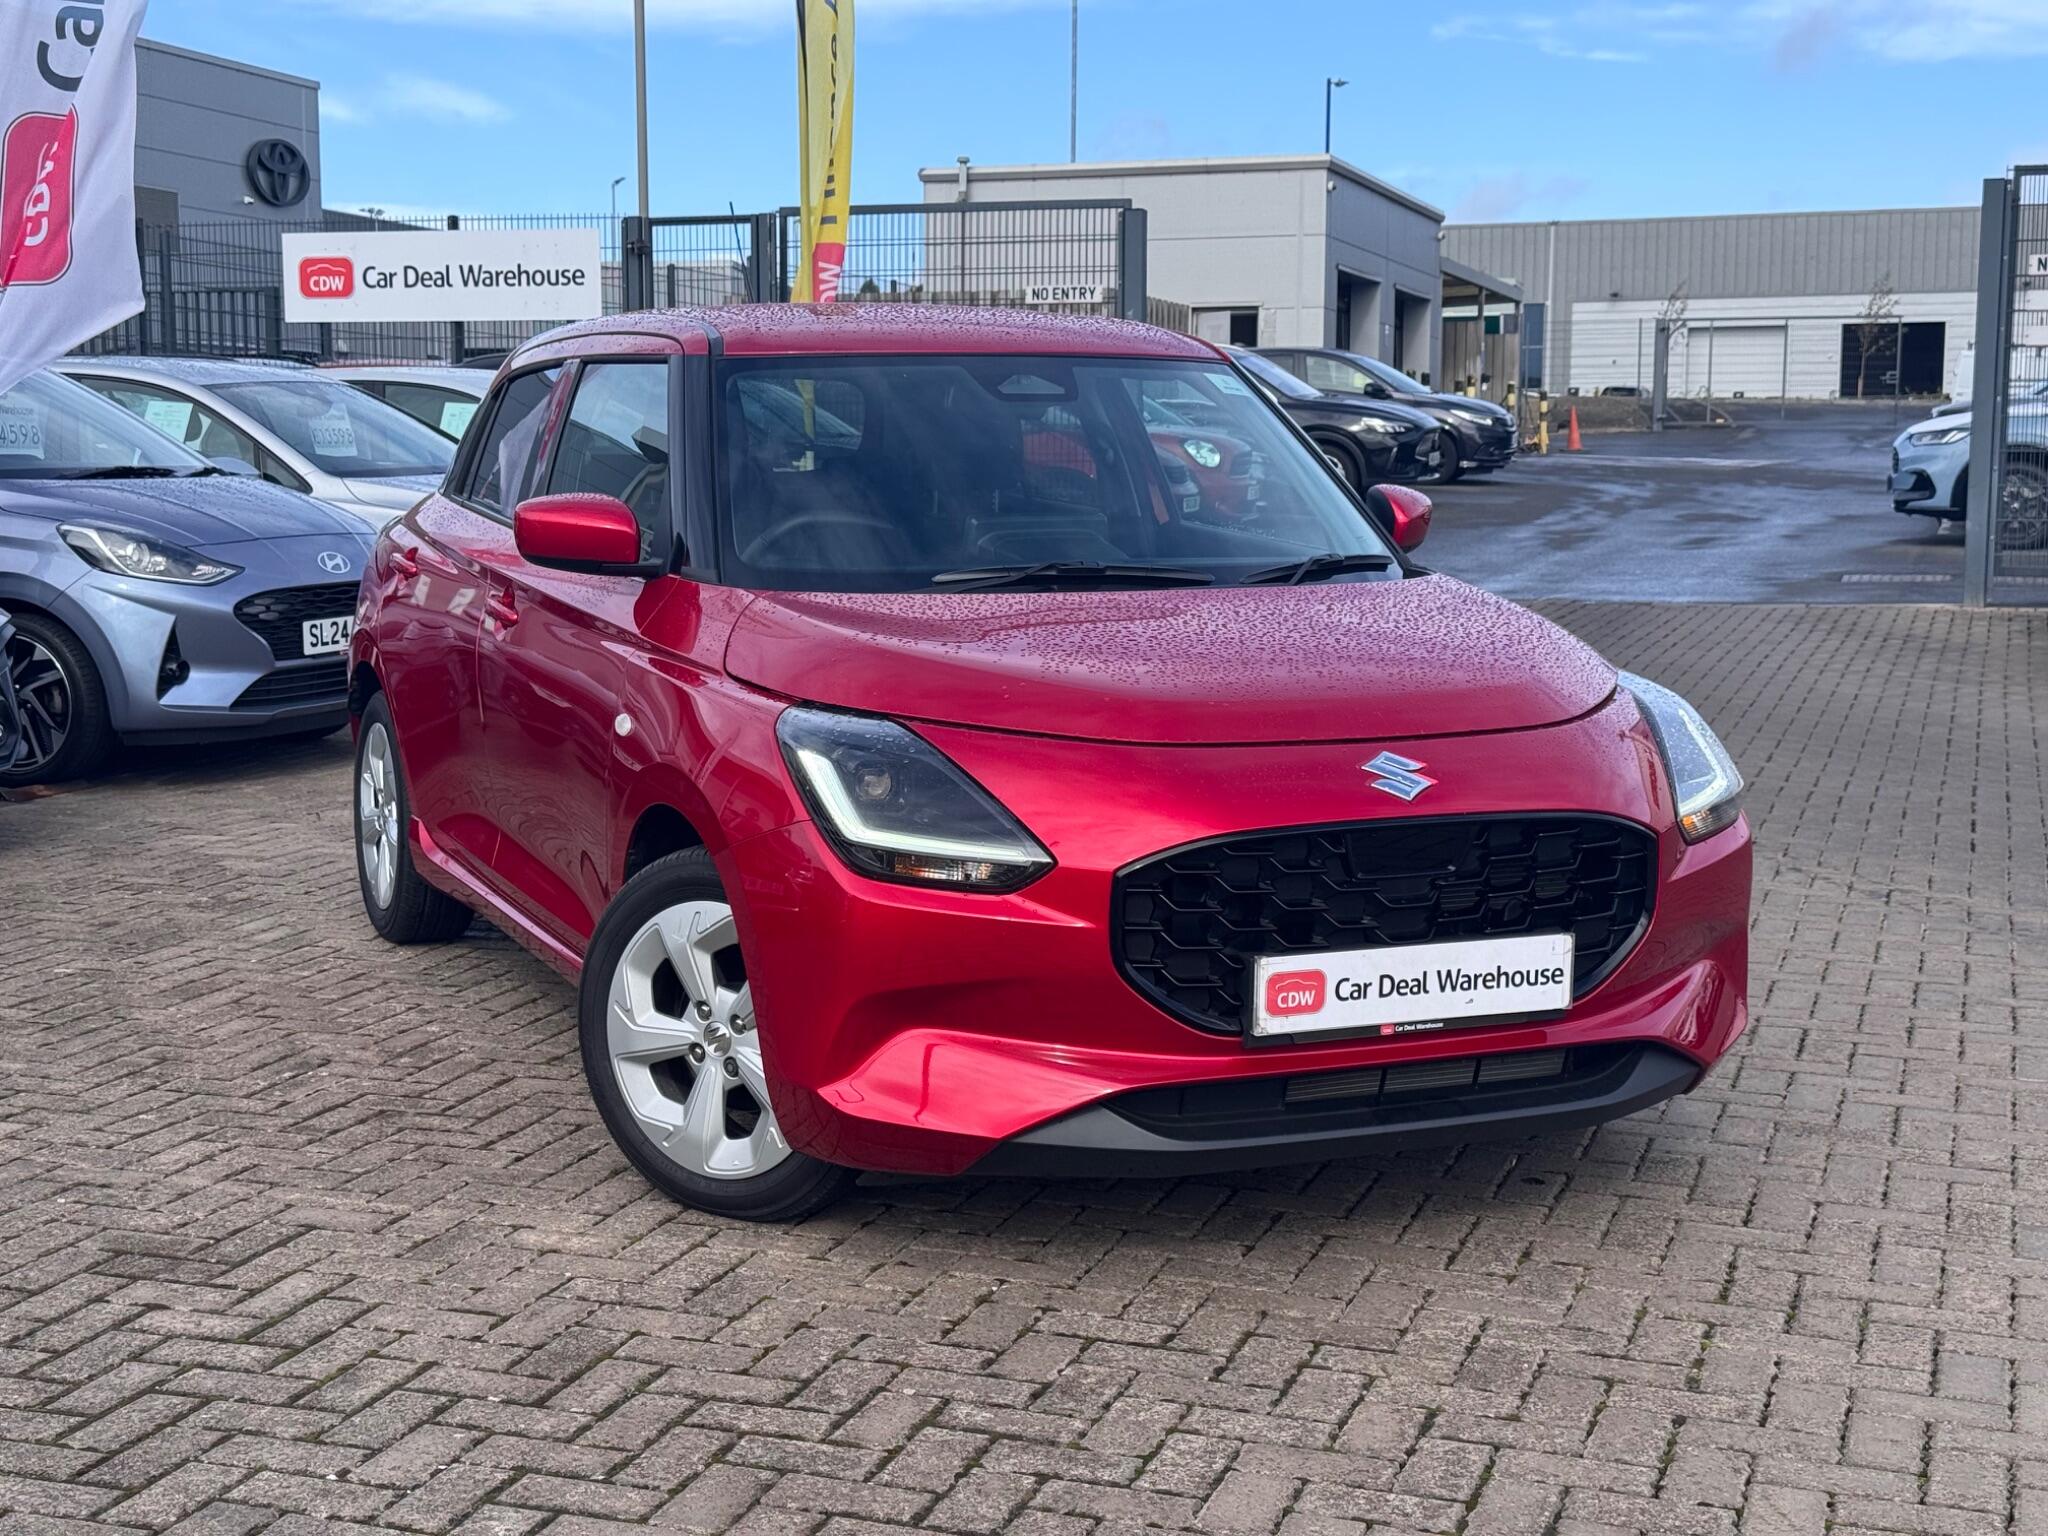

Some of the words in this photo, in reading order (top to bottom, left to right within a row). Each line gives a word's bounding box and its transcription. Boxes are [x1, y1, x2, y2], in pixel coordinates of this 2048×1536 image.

[37, 0, 104, 92] Ca
[309, 275, 345, 292] CDW
[362, 266, 397, 289] Car
[403, 264, 453, 288] Deal
[459, 263, 585, 288] Warehouse
[1032, 287, 1049, 301] NO
[1052, 286, 1097, 300] ENTRY
[309, 620, 350, 648] SL24
[1335, 977, 1372, 1002] Car
[1378, 970, 1429, 998] Deal
[1437, 965, 1564, 993] Warehouse
[1277, 990, 1316, 1008] CDW
